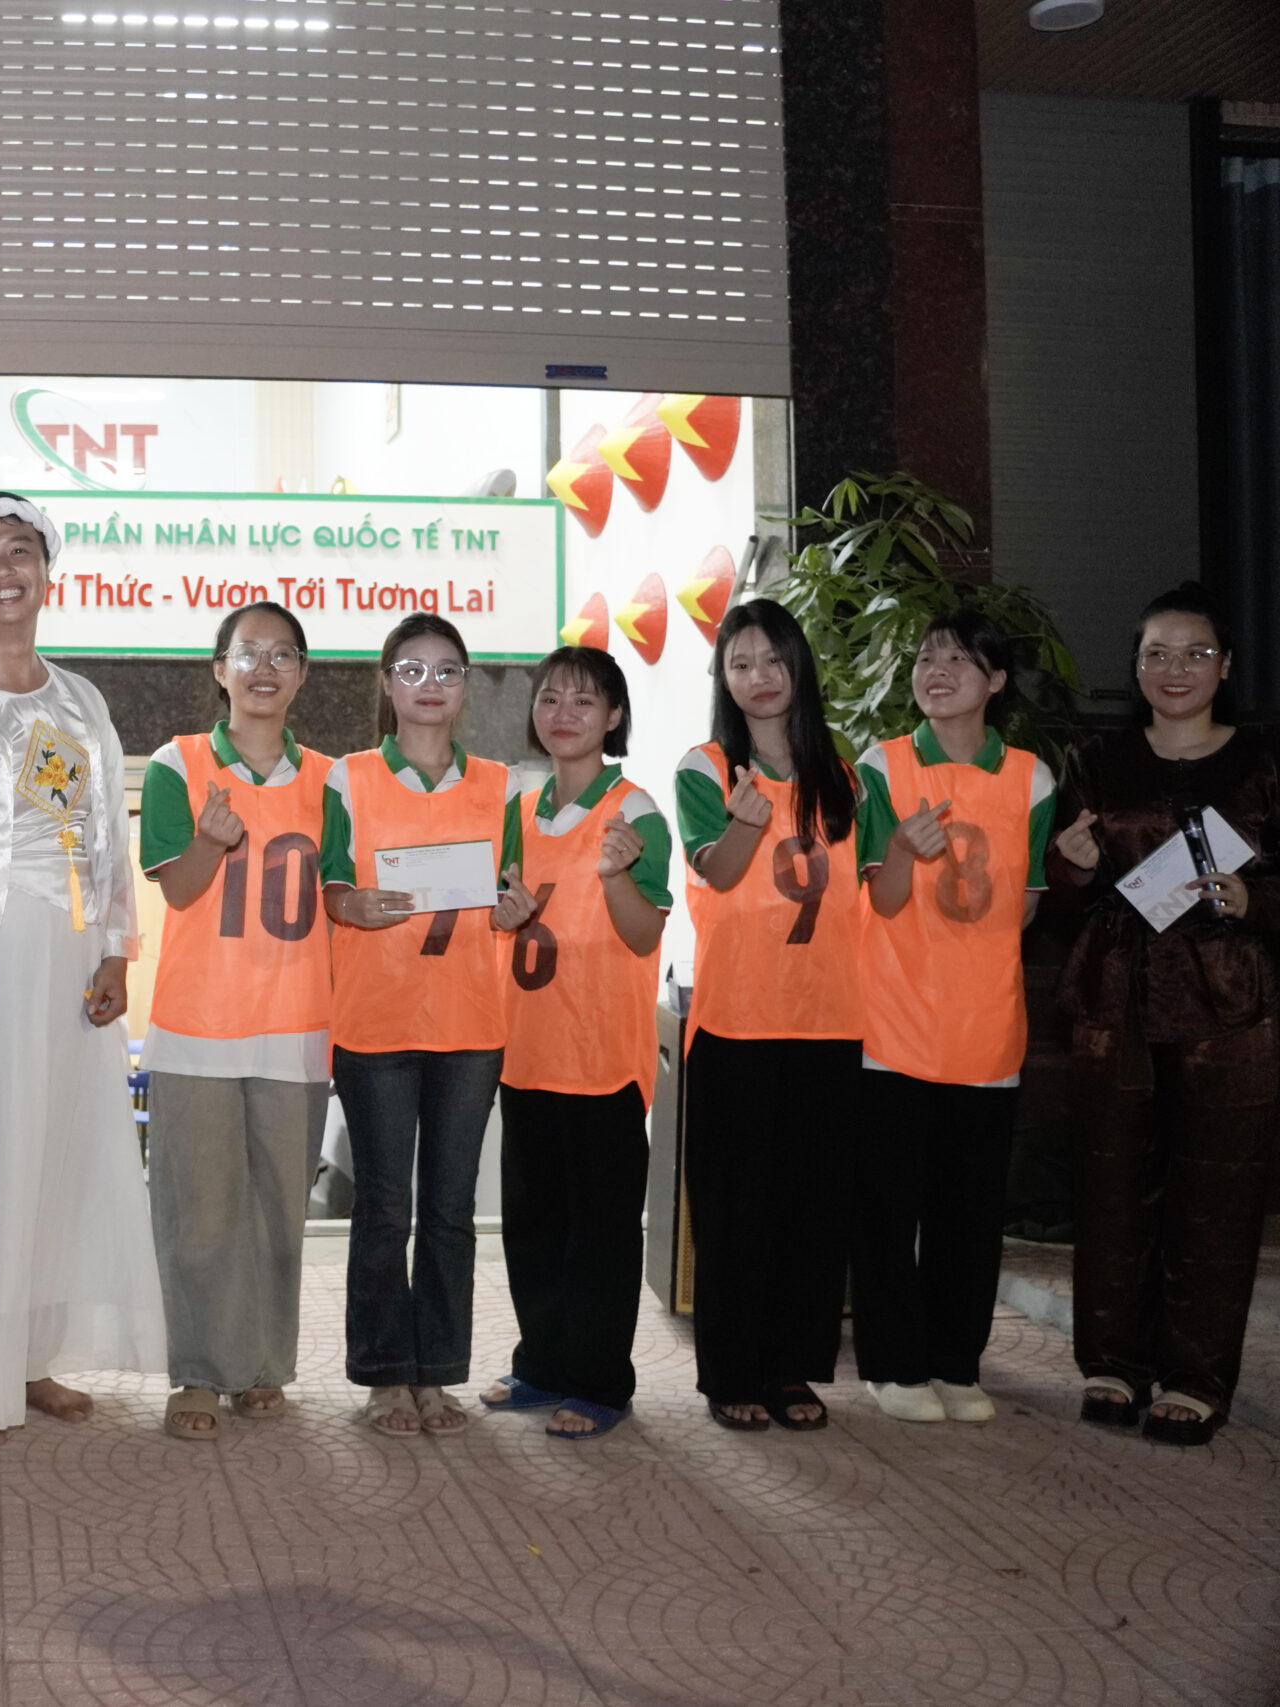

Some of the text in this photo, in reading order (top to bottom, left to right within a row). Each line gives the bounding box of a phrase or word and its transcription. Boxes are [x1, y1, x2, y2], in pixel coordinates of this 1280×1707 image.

[35, 424, 158, 475] TNT
[64, 511, 500, 552] PHẦN NHÂN LỰC QUỐC TẾ TNT
[44, 573, 67, 606] rí
[74, 573, 153, 607] Thức
[182, 576, 268, 608] Vươn
[277, 577, 325, 609] Tới
[336, 578, 438, 615] Tương
[447, 580, 495, 612] Lai
[220, 831, 320, 941] 10
[773, 836, 829, 944] 9
[935, 821, 993, 923] 8
[512, 883, 558, 991] 6
